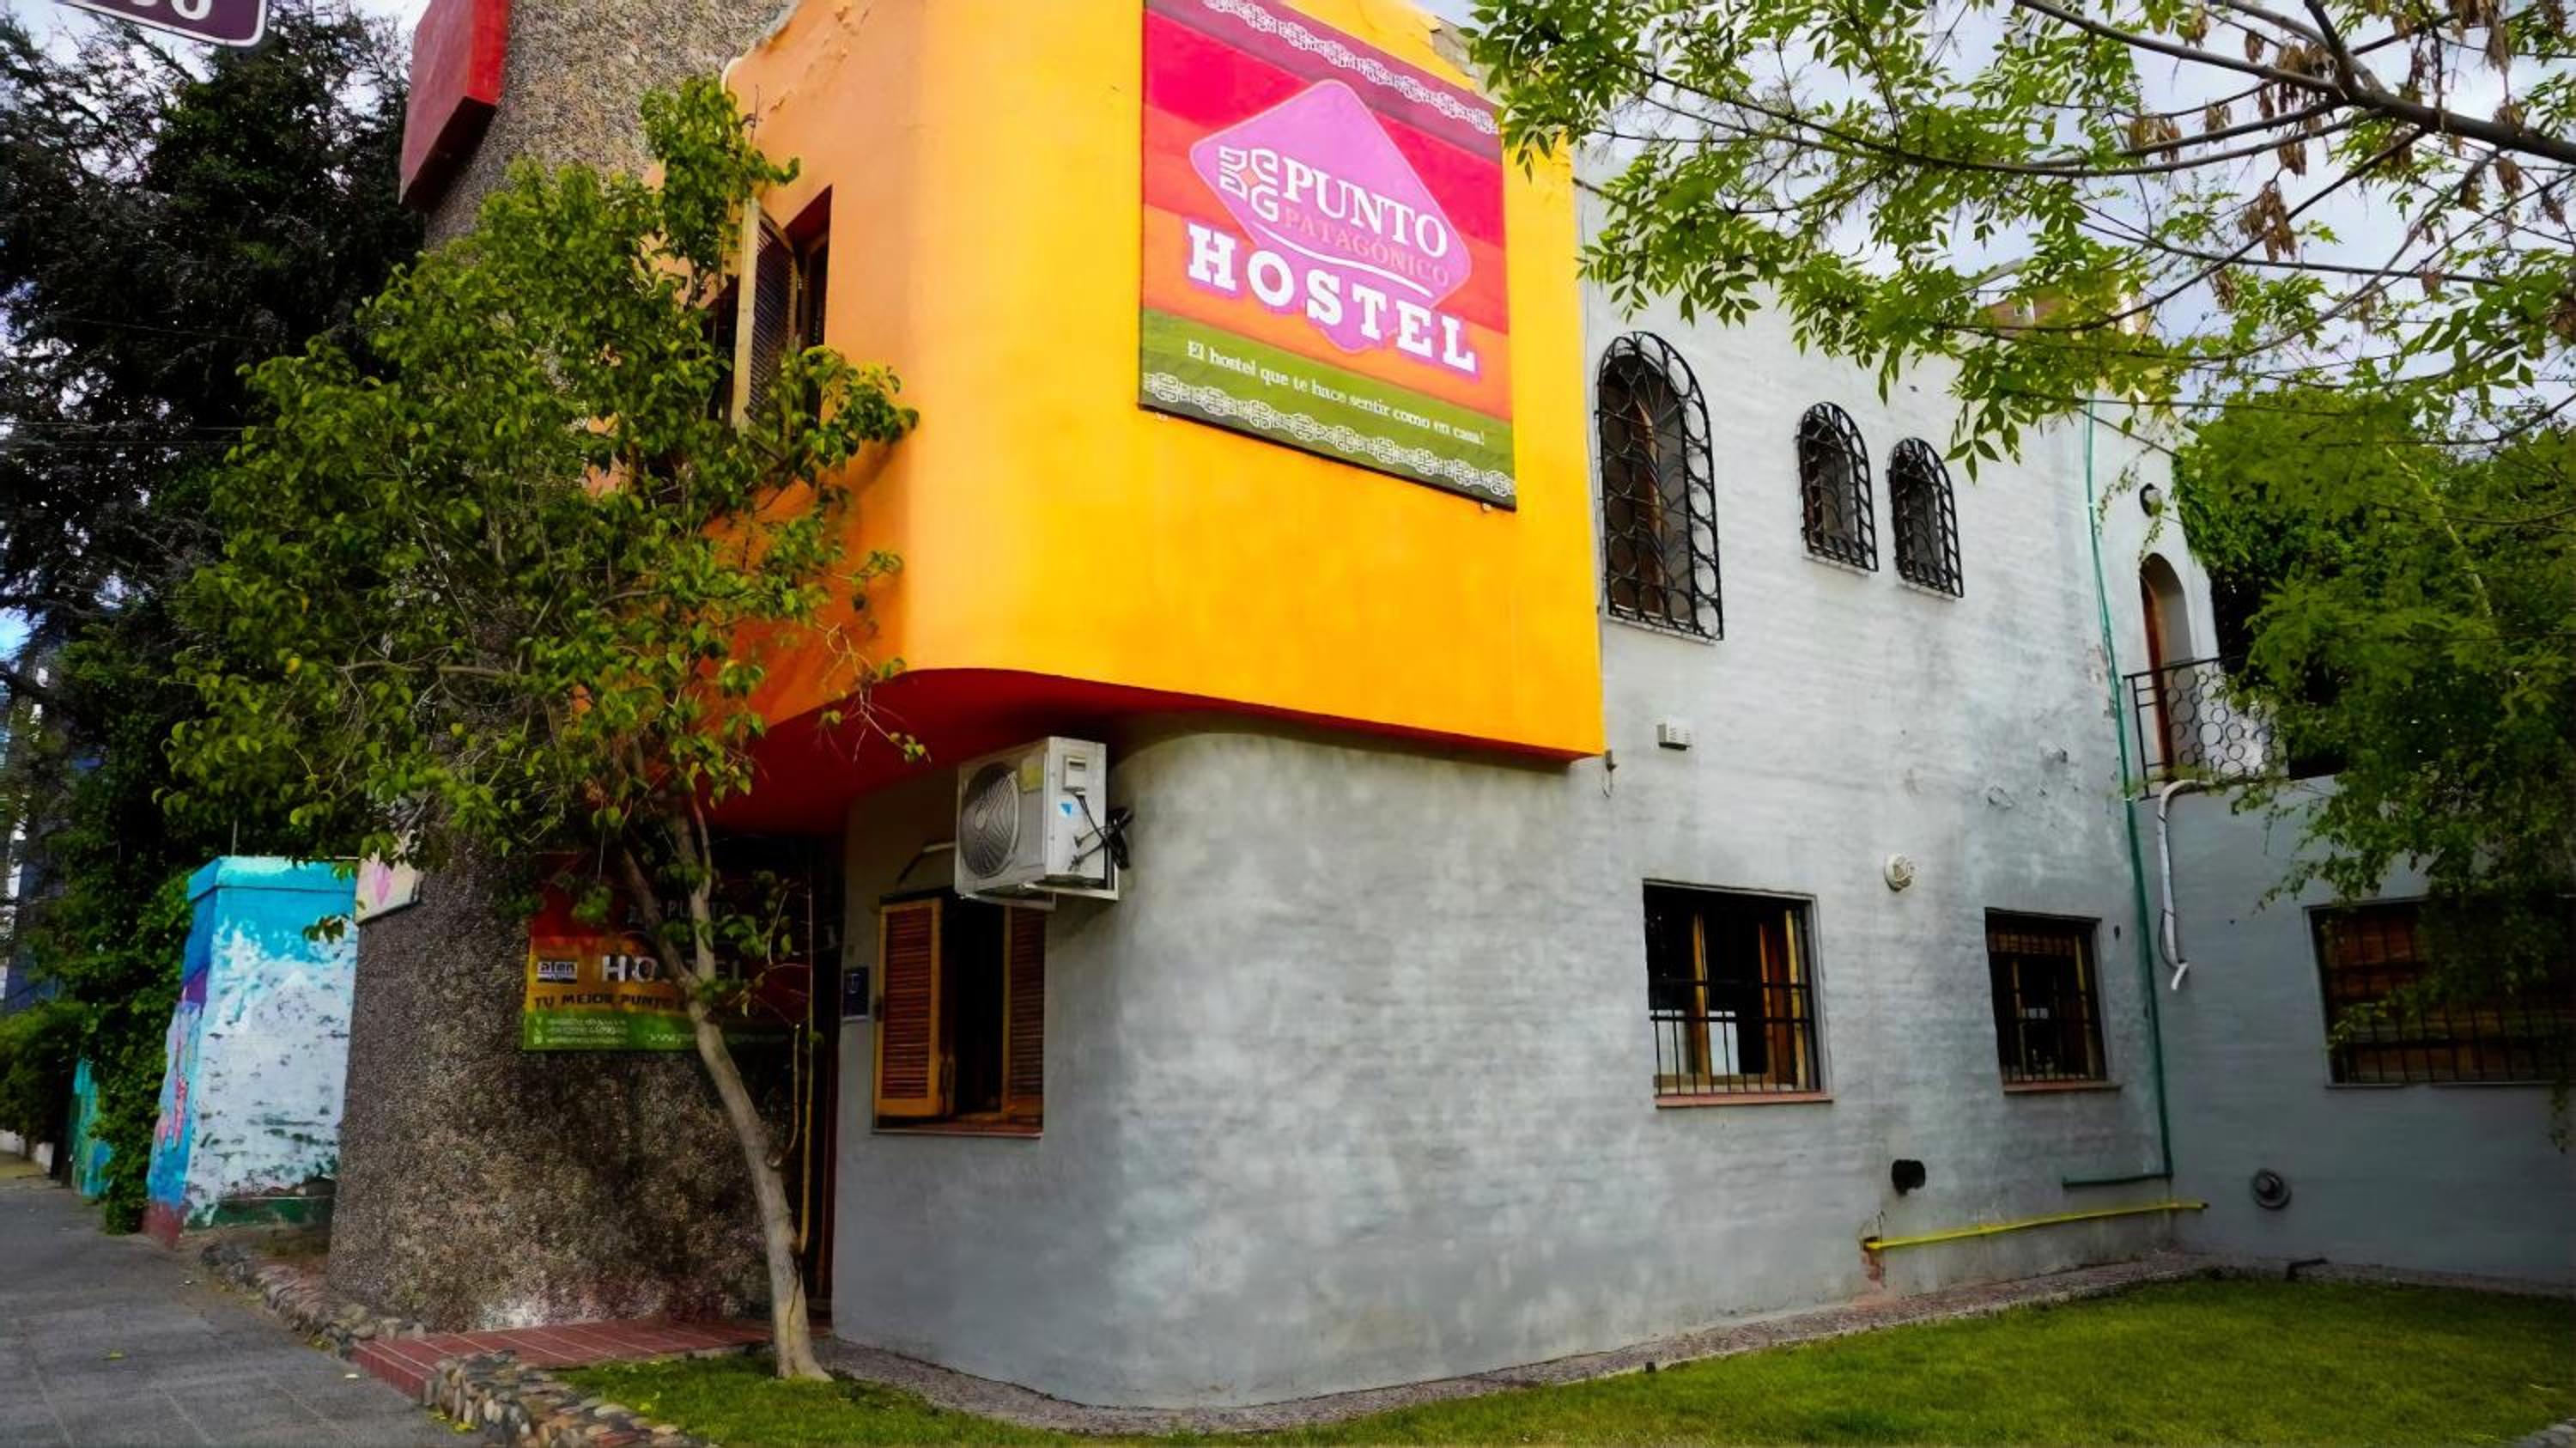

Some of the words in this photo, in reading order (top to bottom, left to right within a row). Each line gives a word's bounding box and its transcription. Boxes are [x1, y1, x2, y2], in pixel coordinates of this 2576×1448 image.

[1283, 157, 1448, 258] PUNTO
[1285, 207, 1449, 286] PATAGÓNICO
[1188, 223, 1477, 373] HOSTEL
[1188, 340, 1204, 360] El
[1210, 347, 1256, 376] hostel
[1261, 368, 1289, 386] que
[1294, 378, 1308, 392] te
[1312, 379, 1346, 403] hace
[1349, 396, 1389, 417] sentir
[1393, 409, 1430, 429] como
[1434, 421, 1449, 435] en
[1453, 428, 1485, 446] casa!
[535, 995, 555, 1007] TU
